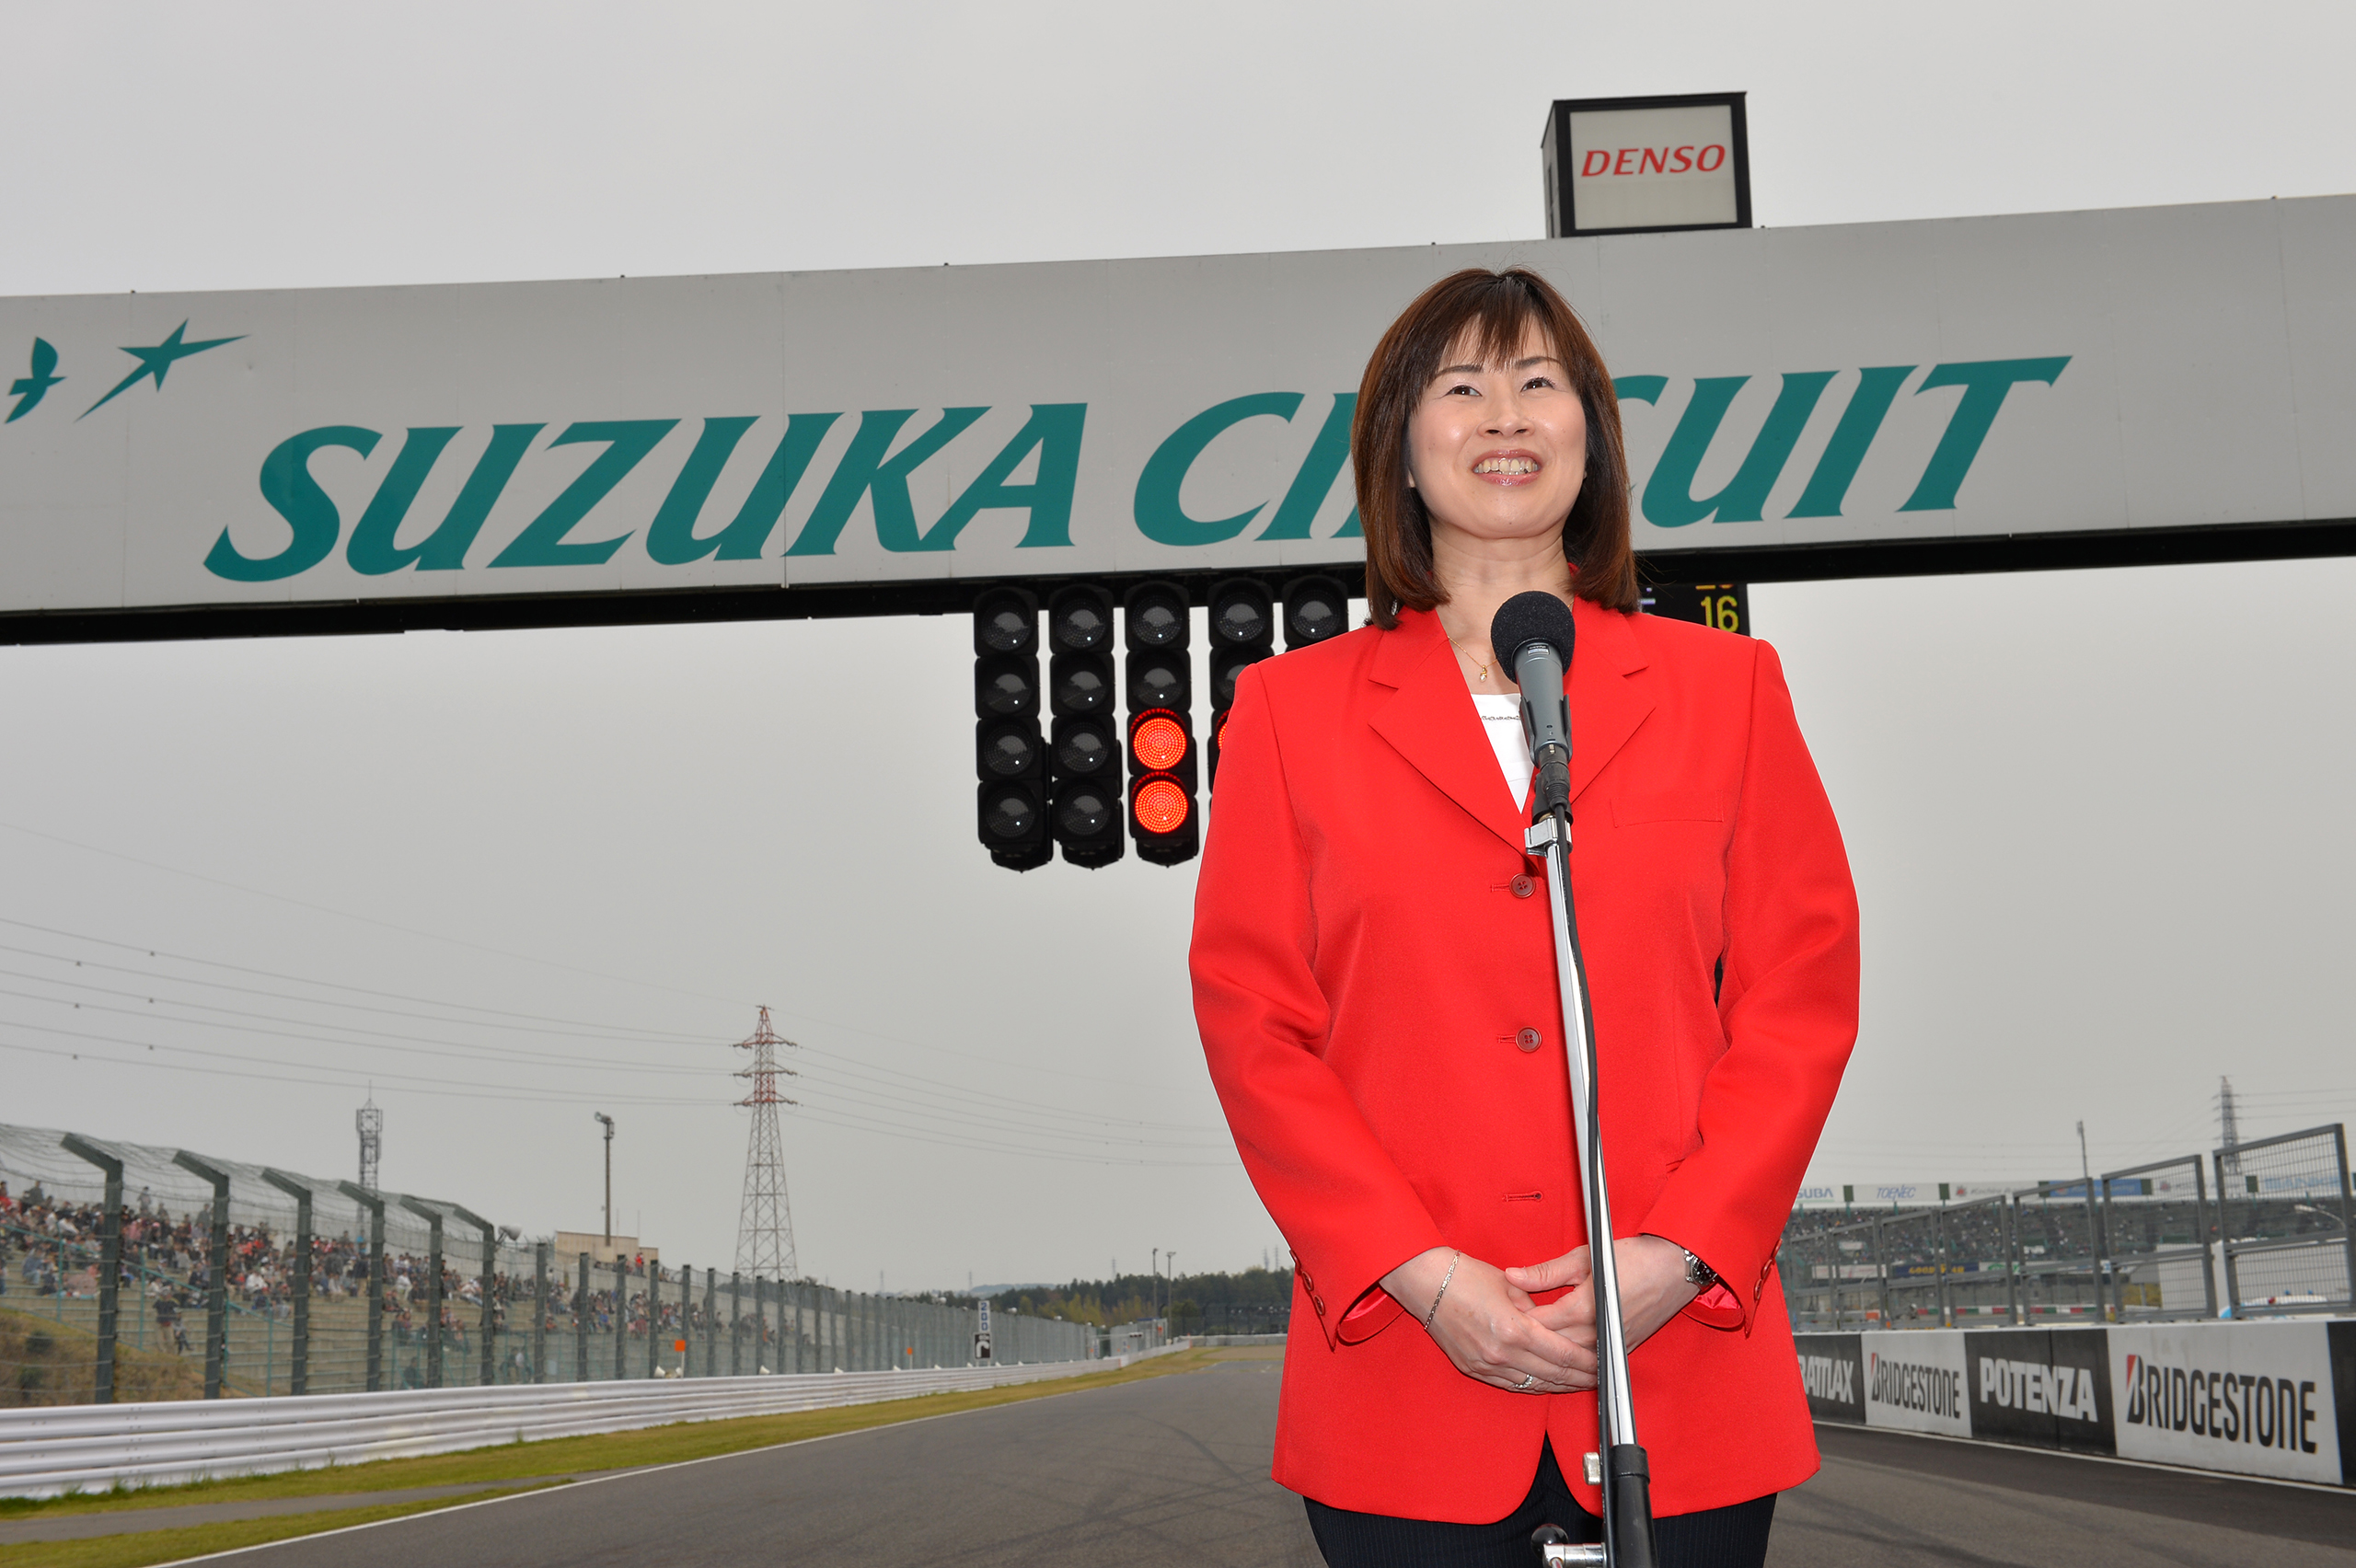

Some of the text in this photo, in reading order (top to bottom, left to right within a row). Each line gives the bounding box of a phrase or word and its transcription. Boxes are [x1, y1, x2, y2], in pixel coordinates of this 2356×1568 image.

[1581, 144, 1726, 177] DENSO
[203, 355, 2073, 582] SUZUKA CIUIT
[1701, 595, 1738, 633] 16
[1871, 1353, 1960, 1419] BRIDGESTONE
[1980, 1356, 2098, 1423] POTENZA
[2127, 1354, 2318, 1455] BRIDGESTONE
